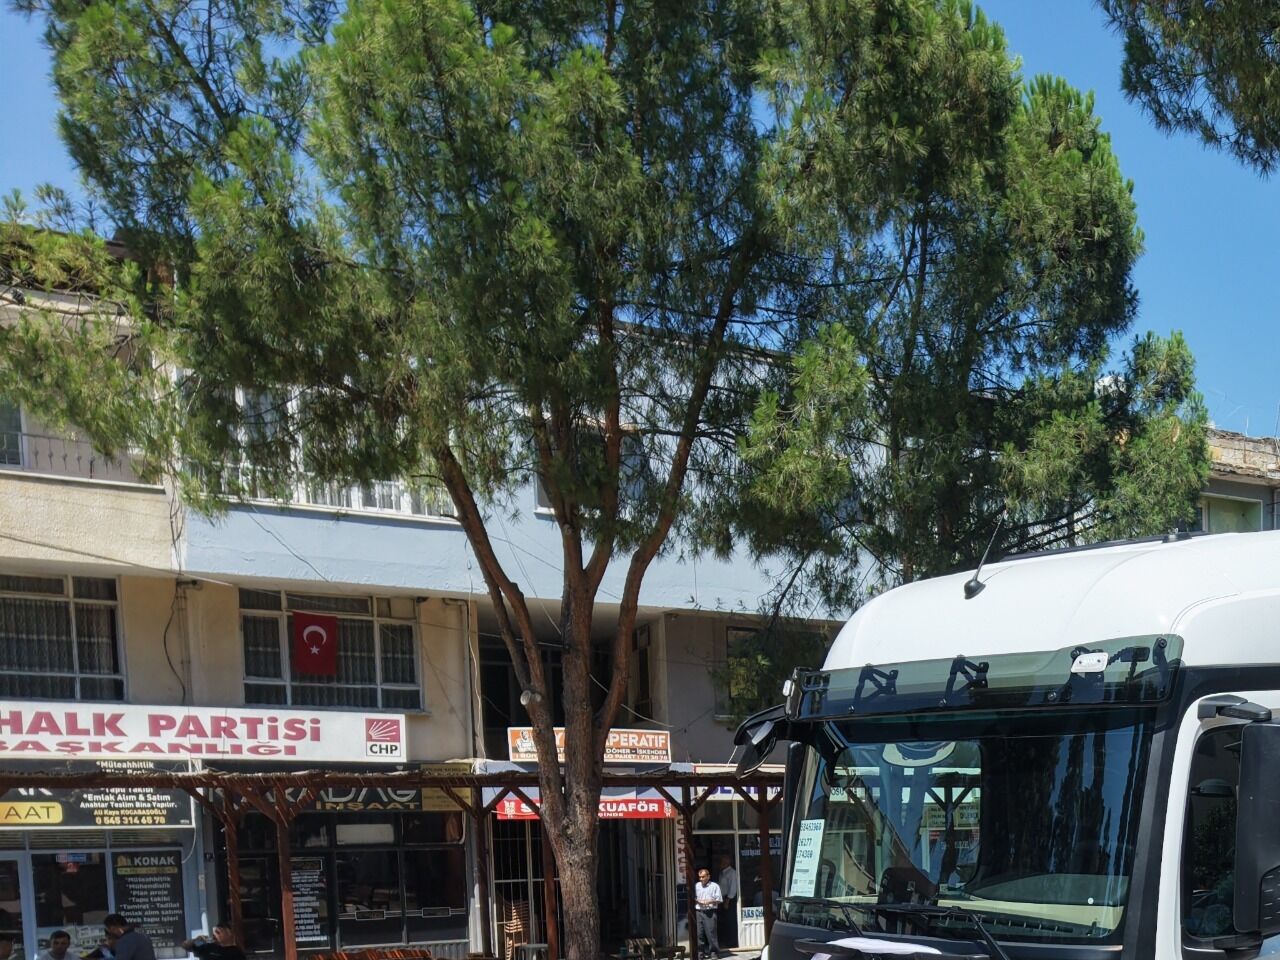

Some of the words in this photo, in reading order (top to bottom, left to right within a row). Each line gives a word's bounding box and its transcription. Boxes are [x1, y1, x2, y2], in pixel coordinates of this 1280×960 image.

[0, 711, 128, 737] HALK
[369, 743, 399, 755] CHP
[133, 856, 176, 866] KONAK
